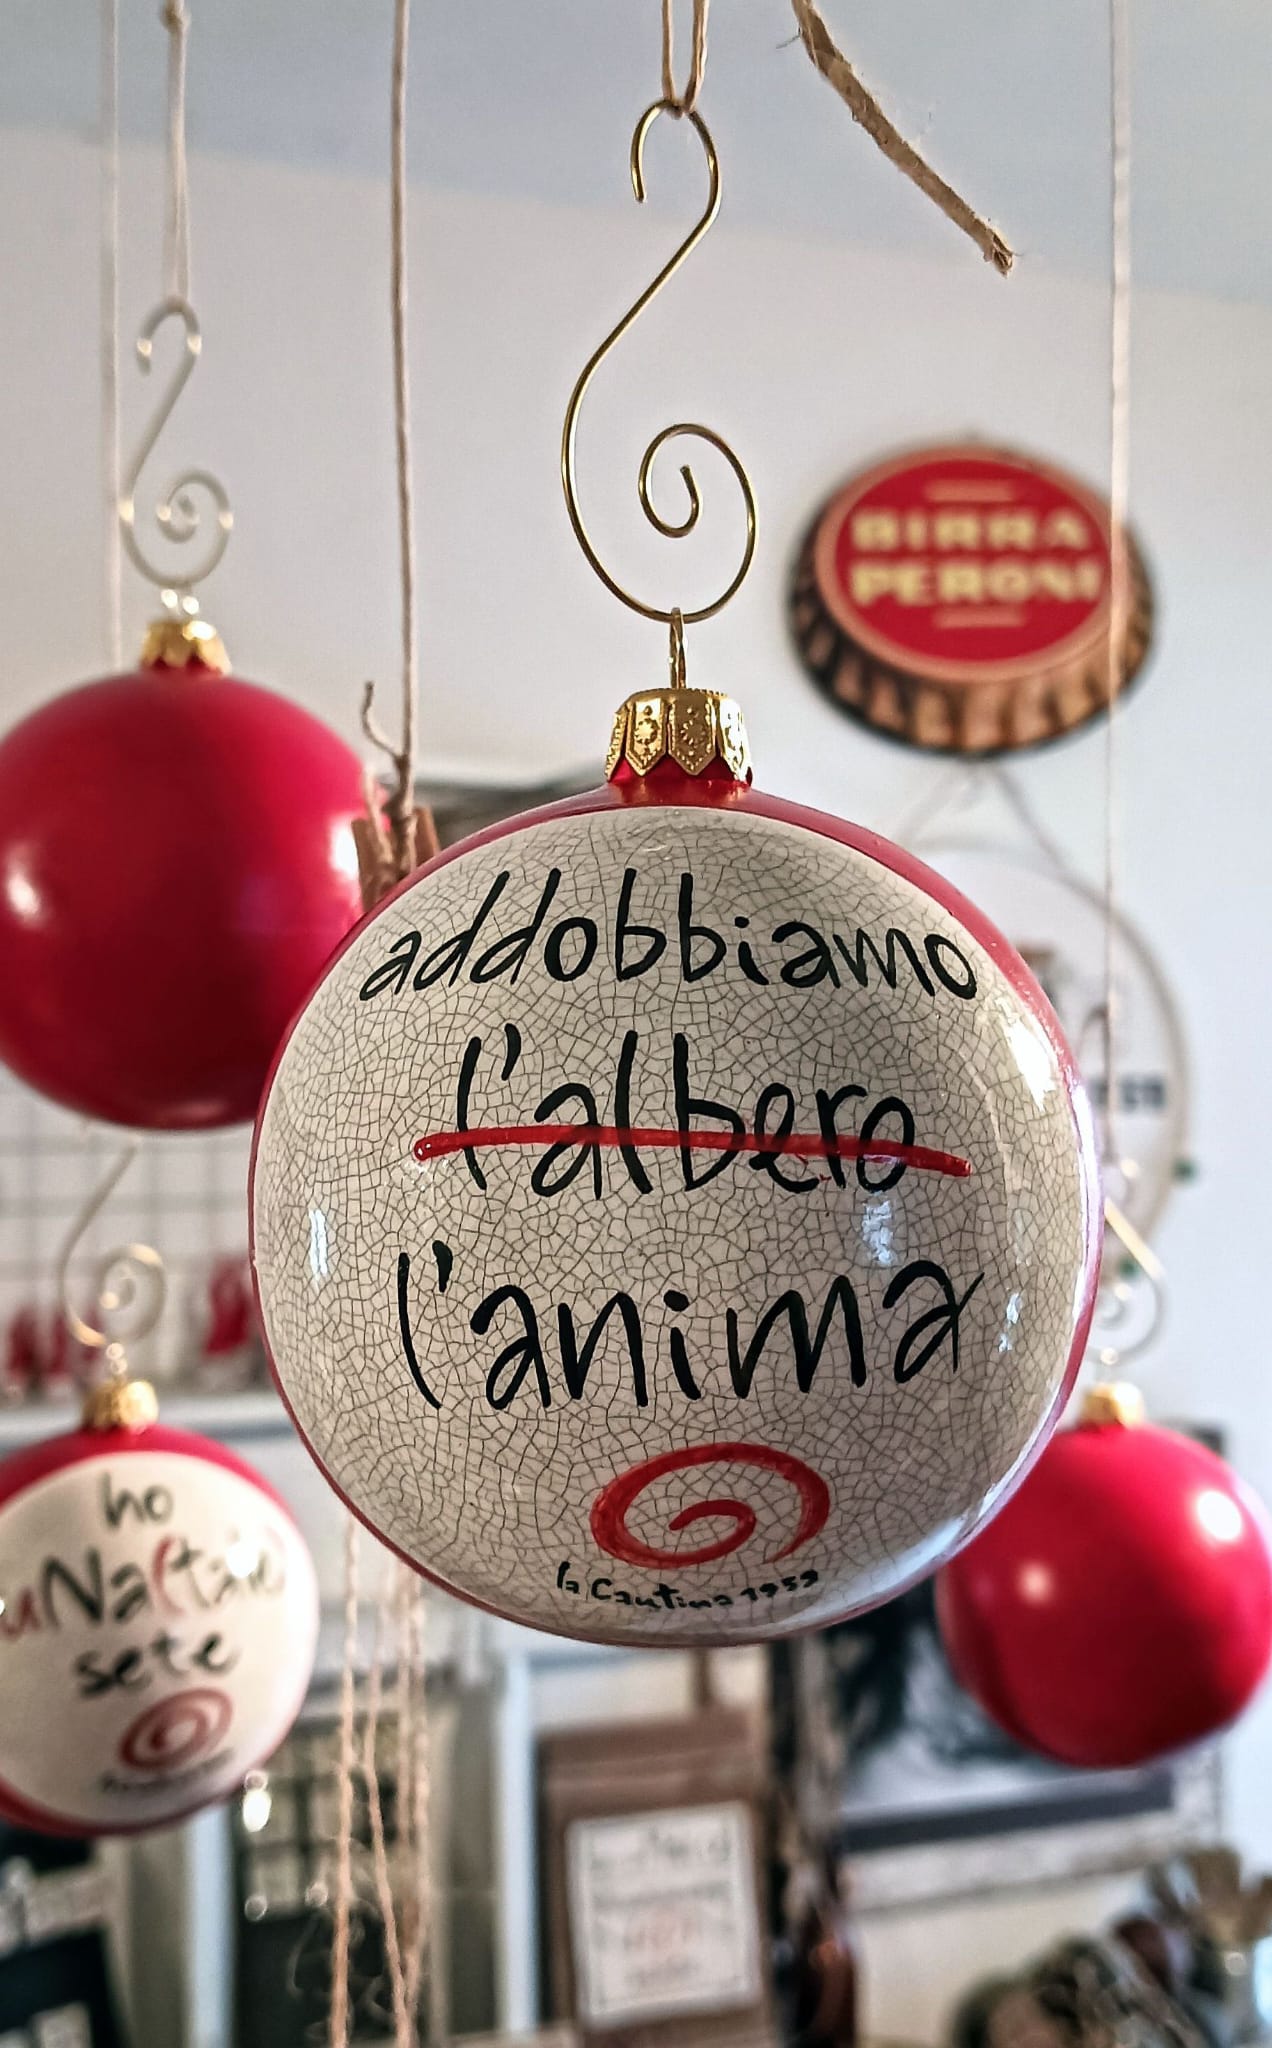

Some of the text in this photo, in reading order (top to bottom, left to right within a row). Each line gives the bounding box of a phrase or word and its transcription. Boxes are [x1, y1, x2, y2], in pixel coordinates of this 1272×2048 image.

[850, 507, 1089, 551] BIRRA
[850, 561, 1100, 606] PERONI
[360, 868, 978, 1000] addobbiamo
[398, 1240, 985, 1410] l'anima
[98, 1471, 174, 1531] ho
[74, 1630, 241, 1698] sete
